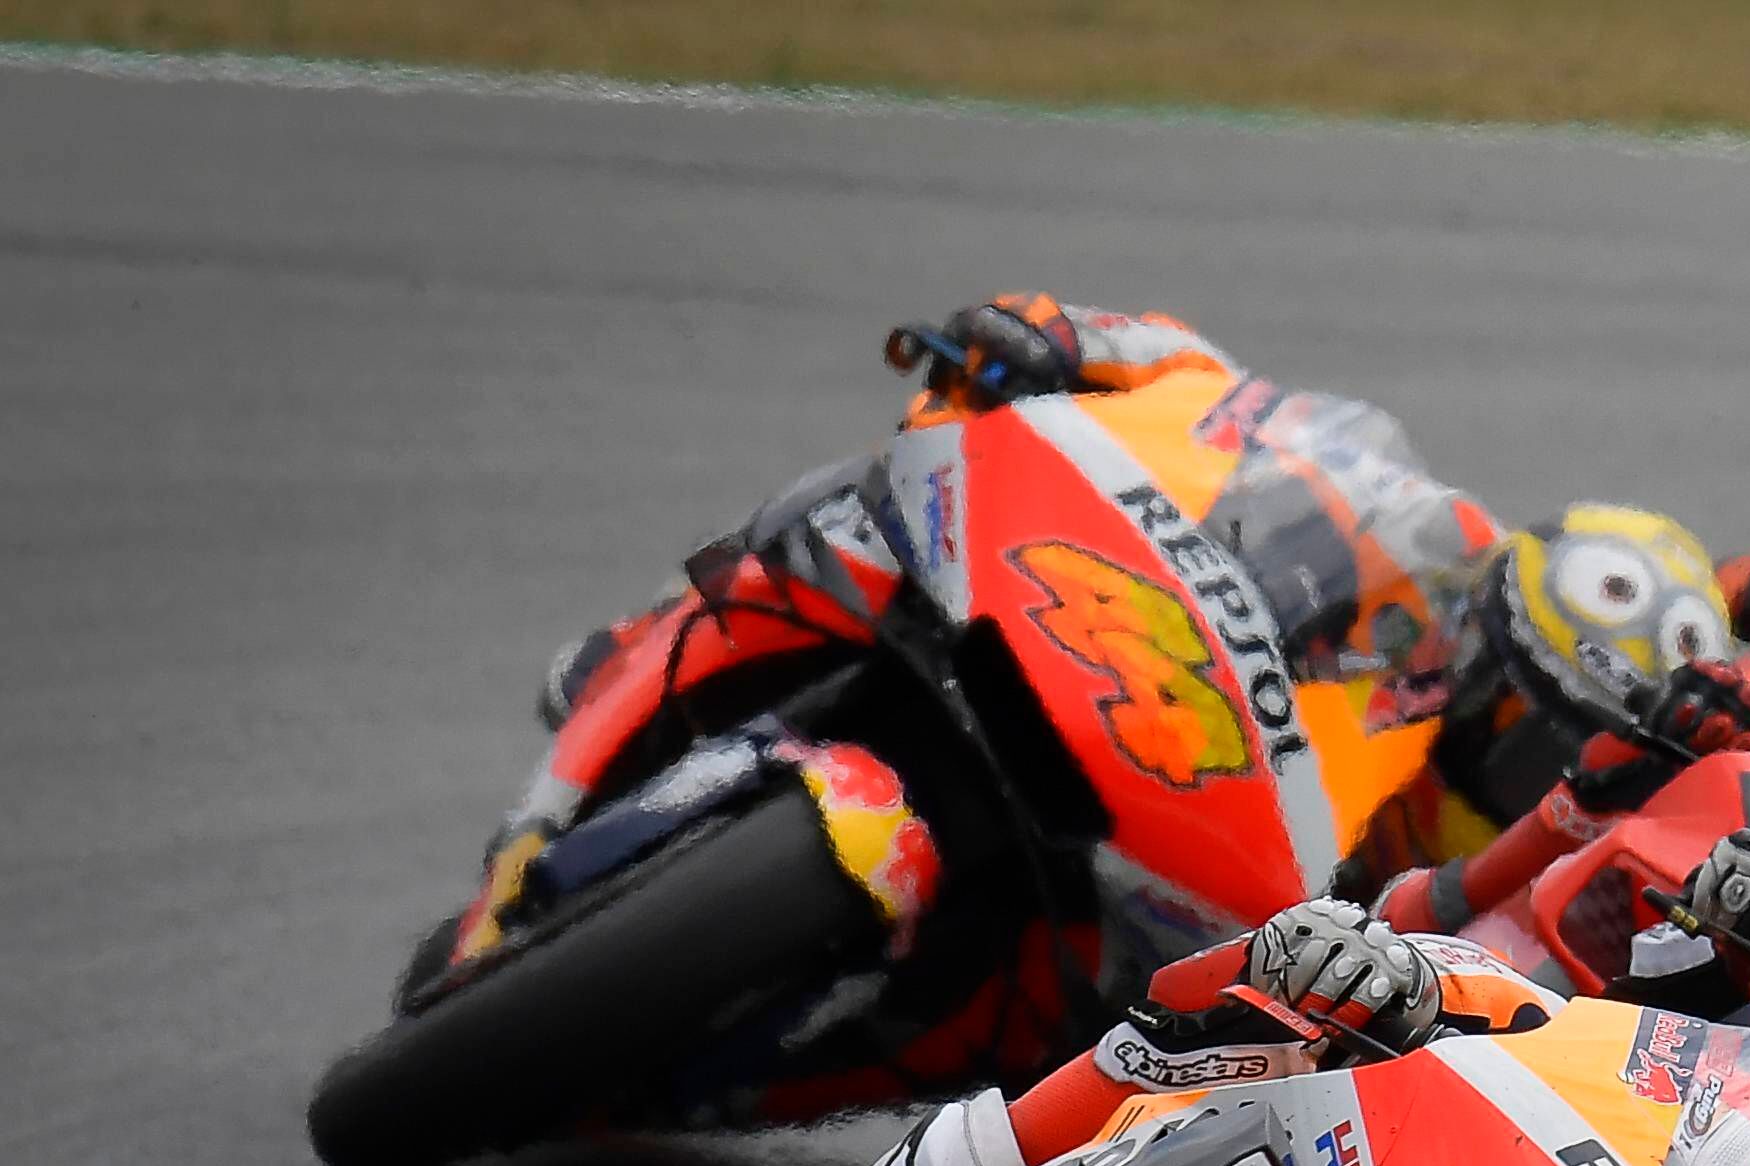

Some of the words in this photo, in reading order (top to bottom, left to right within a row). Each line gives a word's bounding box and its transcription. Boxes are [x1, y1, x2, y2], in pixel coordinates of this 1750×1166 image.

[1114, 484, 1310, 775] REPSOL
[1113, 1040, 1269, 1088] alpinestars
[1694, 1073, 1724, 1122] Puig
